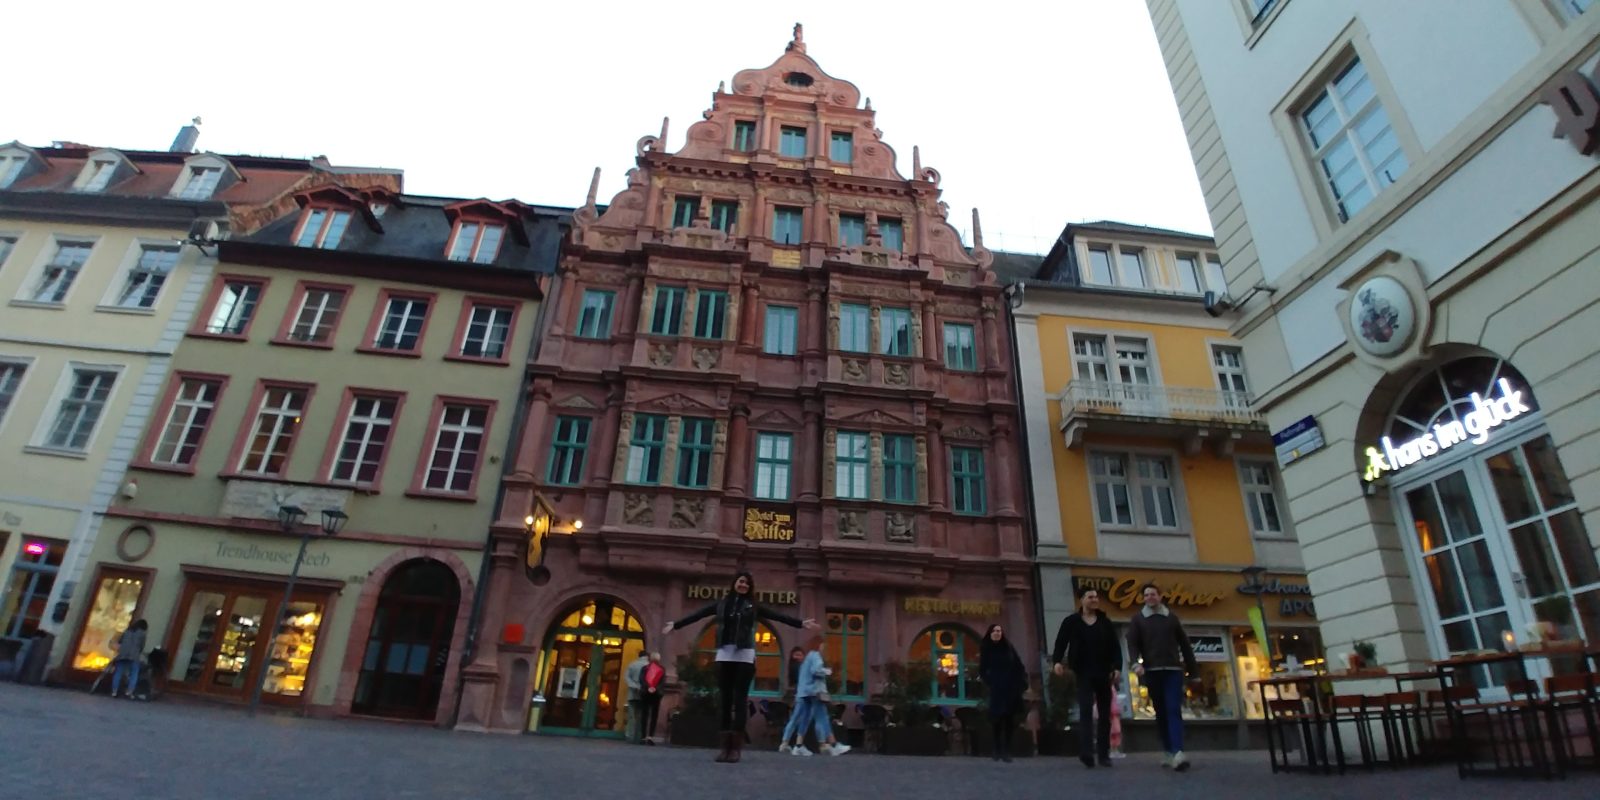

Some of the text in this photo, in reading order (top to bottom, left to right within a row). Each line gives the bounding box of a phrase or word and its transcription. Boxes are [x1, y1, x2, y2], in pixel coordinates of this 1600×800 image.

[1382, 436, 1438, 471] hans
[1432, 419, 1467, 450] im
[744, 520, 794, 541] Ritter
[216, 540, 292, 563] Trendhouse
[1077, 576, 1111, 591] FOTO
[687, 584, 798, 605] HOTE TTER
